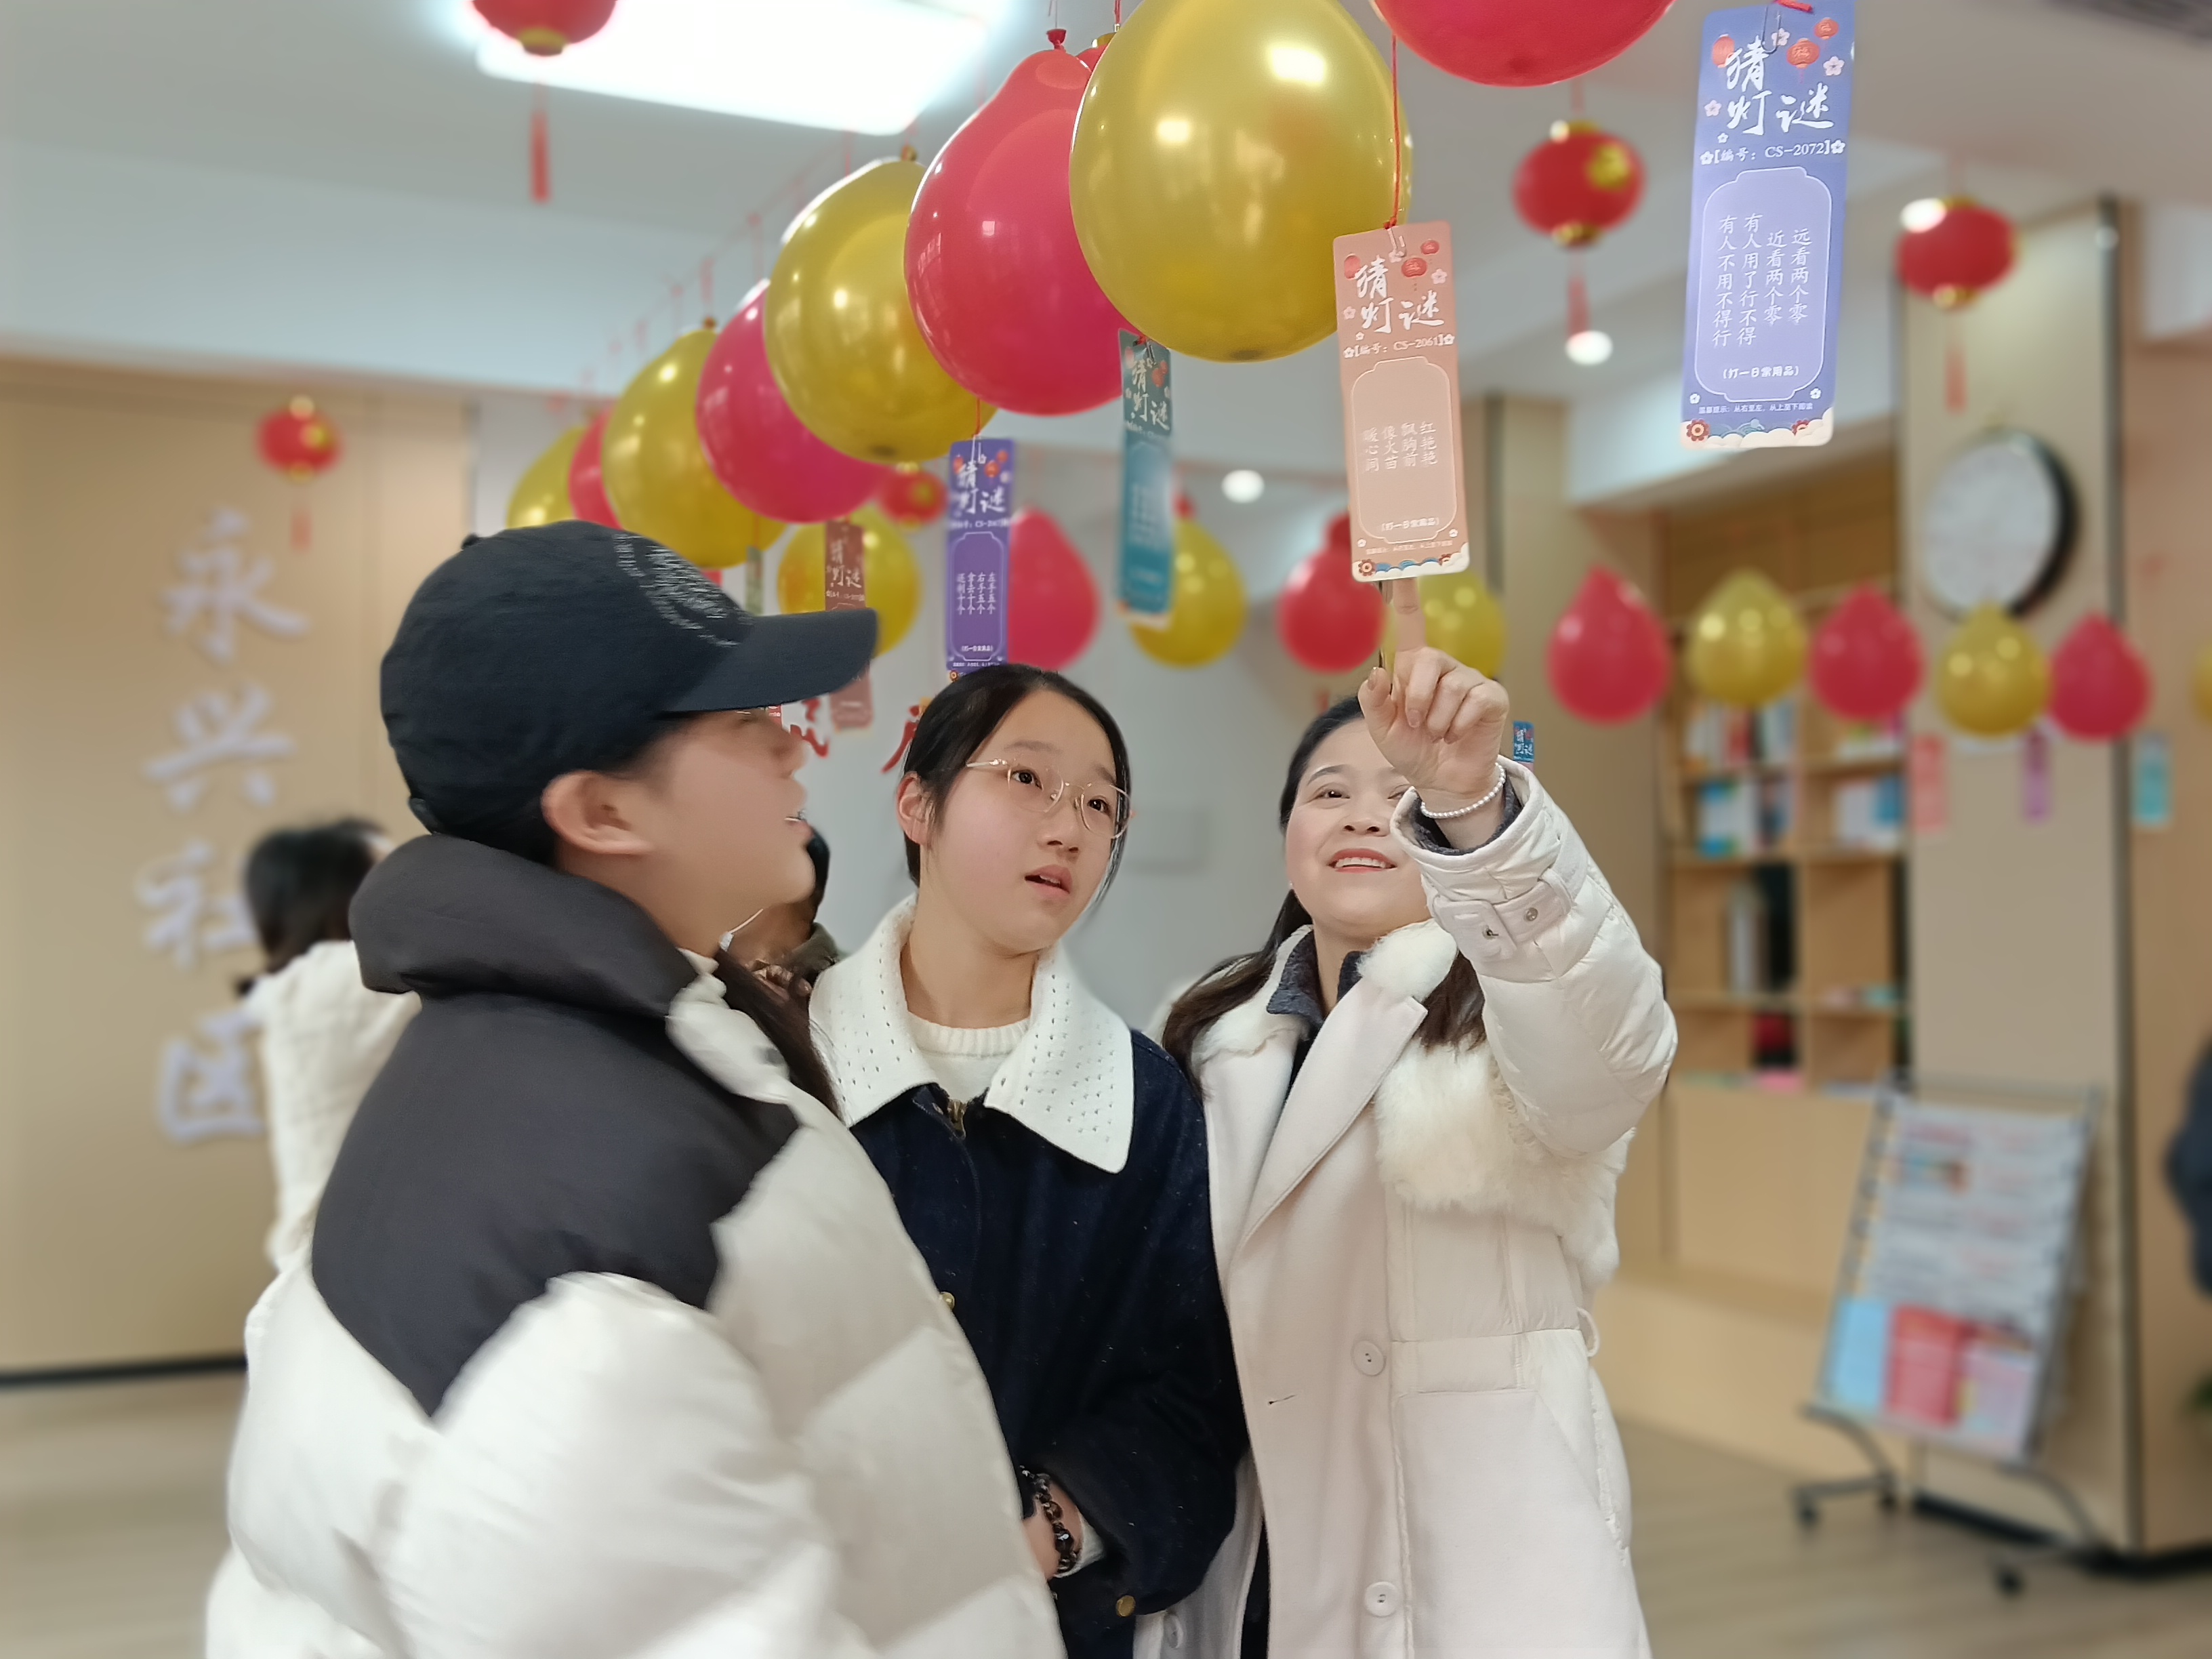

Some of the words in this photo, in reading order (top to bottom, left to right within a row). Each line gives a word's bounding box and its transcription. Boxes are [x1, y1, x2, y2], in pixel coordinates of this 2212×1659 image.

[1726, 35, 1769, 92] 猜
[1727, 82, 1835, 136] 灯谜
[1354, 255, 1389, 299] 猜
[1712, 215, 1738, 348] 有人不用不得行
[1736, 213, 1763, 347] 有人用了行不得
[1763, 229, 1788, 325] 近看两个零
[1788, 228, 1813, 325] 远看两个零
[1361, 289, 1445, 333] 灯谜
[1133, 391, 1170, 430] 灯谜
[1363, 427, 1380, 471] 暖心间
[1382, 426, 1399, 469] 像火苗
[1401, 422, 1419, 467] 飘胸前
[1419, 421, 1438, 466] 红艳艳
[960, 485, 1005, 514] 灯谜
[976, 571, 987, 615] 右手五个
[987, 571, 997, 615] 左手五个
